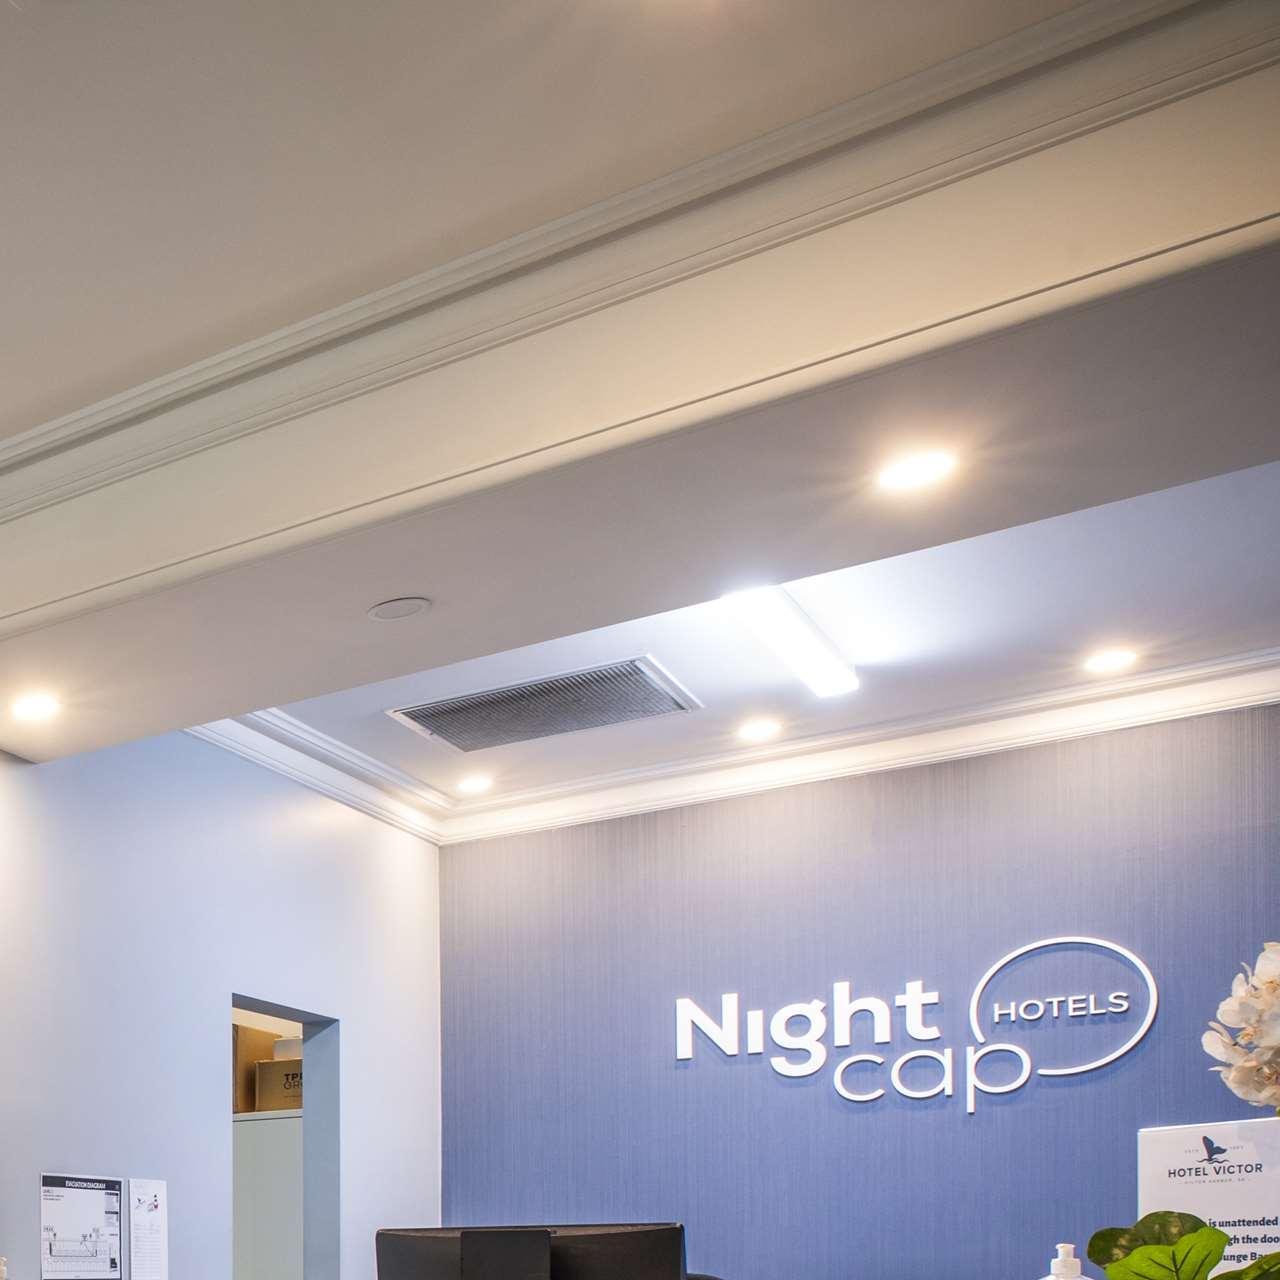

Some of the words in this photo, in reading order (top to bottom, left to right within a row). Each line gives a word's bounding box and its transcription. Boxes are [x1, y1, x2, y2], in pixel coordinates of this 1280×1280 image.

[993, 991, 1130, 1023] HOTELS
[676, 980, 942, 1077] Night
[833, 1043, 1032, 1114] cap
[1168, 1167, 1208, 1178] HOTEL
[1213, 1163, 1263, 1176] VICTOR
[1208, 1218, 1217, 1228] is
[1218, 1216, 1279, 1228] unattended
[1241, 1234, 1258, 1244] the
[1260, 1234, 1280, 1244] doo
[1220, 1253, 1249, 1263] unge
